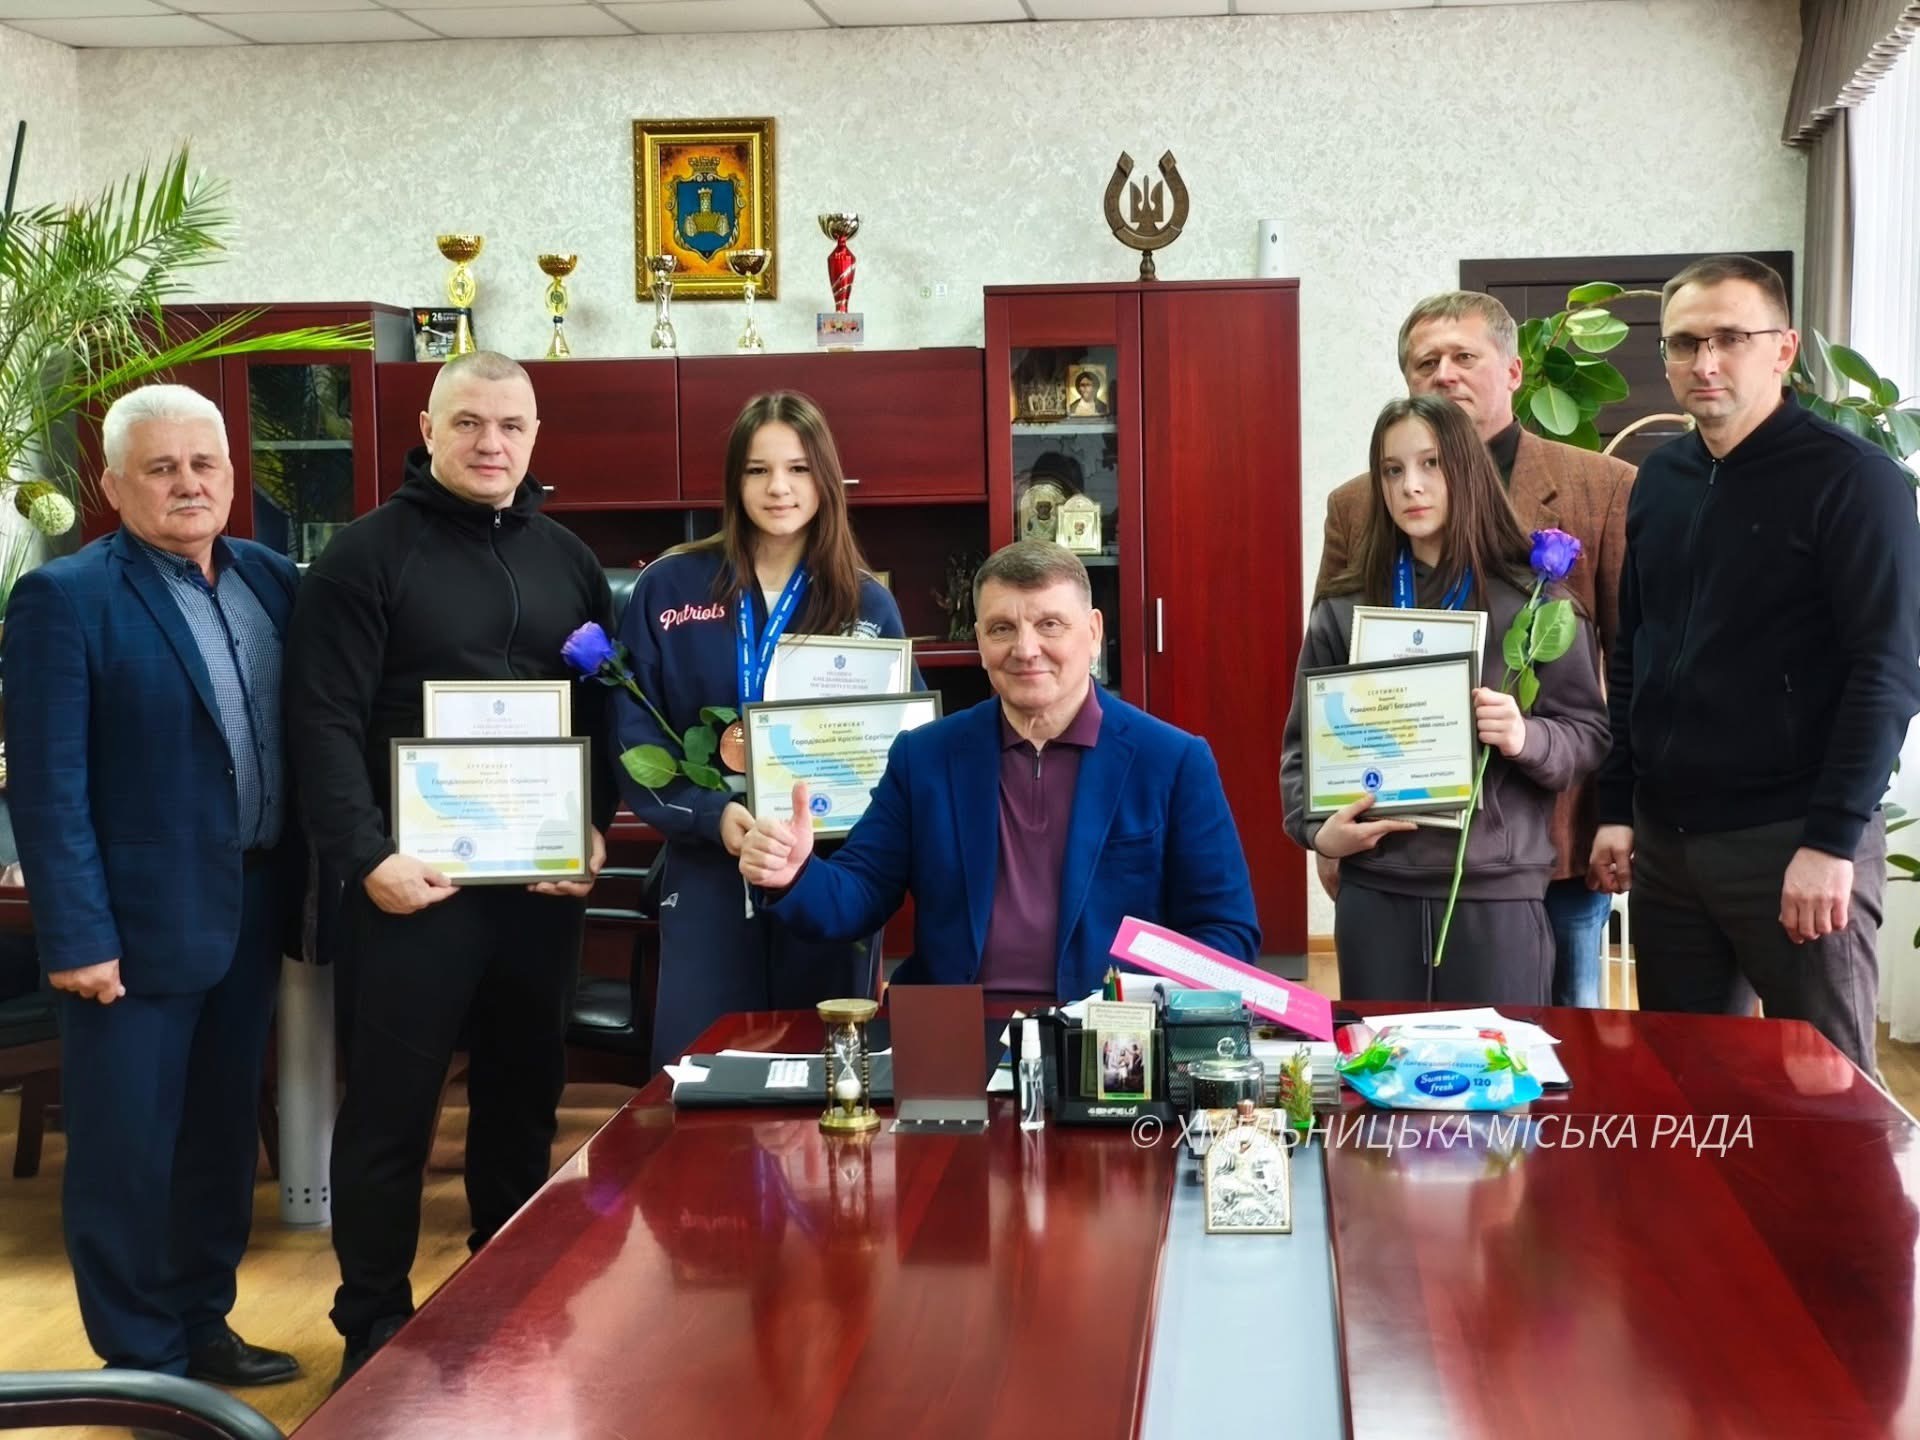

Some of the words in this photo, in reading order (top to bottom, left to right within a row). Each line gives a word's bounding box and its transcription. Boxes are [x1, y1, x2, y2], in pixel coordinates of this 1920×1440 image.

[659, 602, 726, 631] Patriots
[1420, 1073, 1460, 1085] Summer
[1473, 1077, 1491, 1087] 120
[1429, 1082, 1454, 1094] fresh
